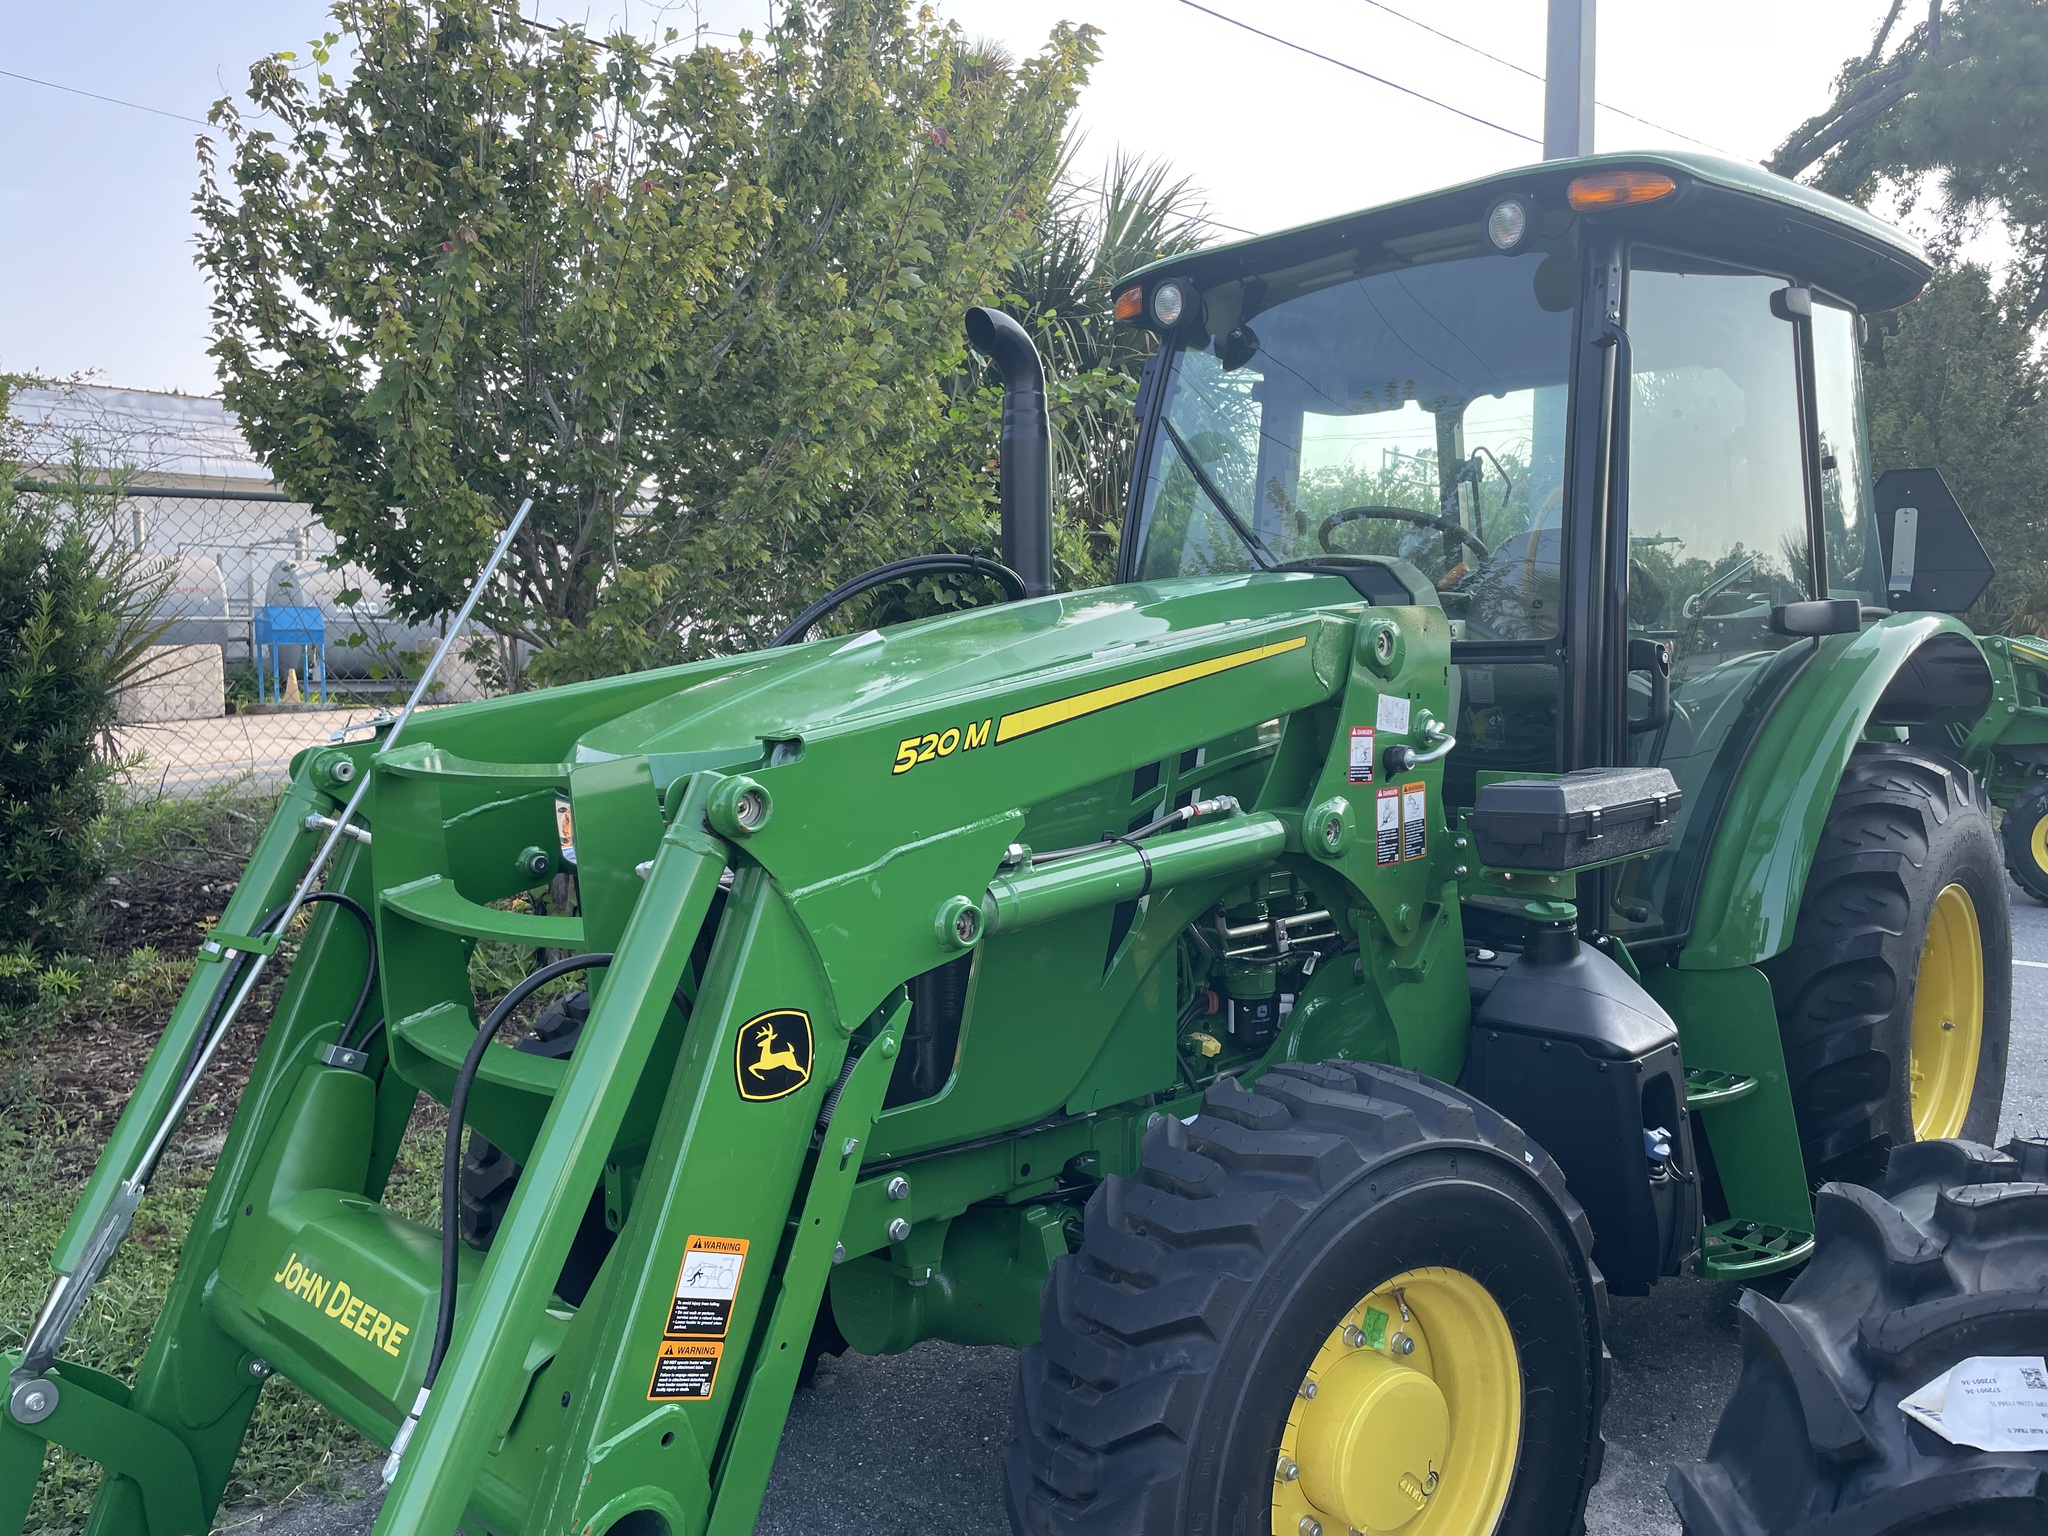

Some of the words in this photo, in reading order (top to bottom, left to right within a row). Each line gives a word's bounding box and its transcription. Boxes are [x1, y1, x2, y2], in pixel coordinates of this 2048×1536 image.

[703, 1240, 741, 1252] WARNING
[274, 1252, 331, 1308] JOHN
[324, 1280, 410, 1357] DEERE
[677, 1346, 716, 1355] WARNING
